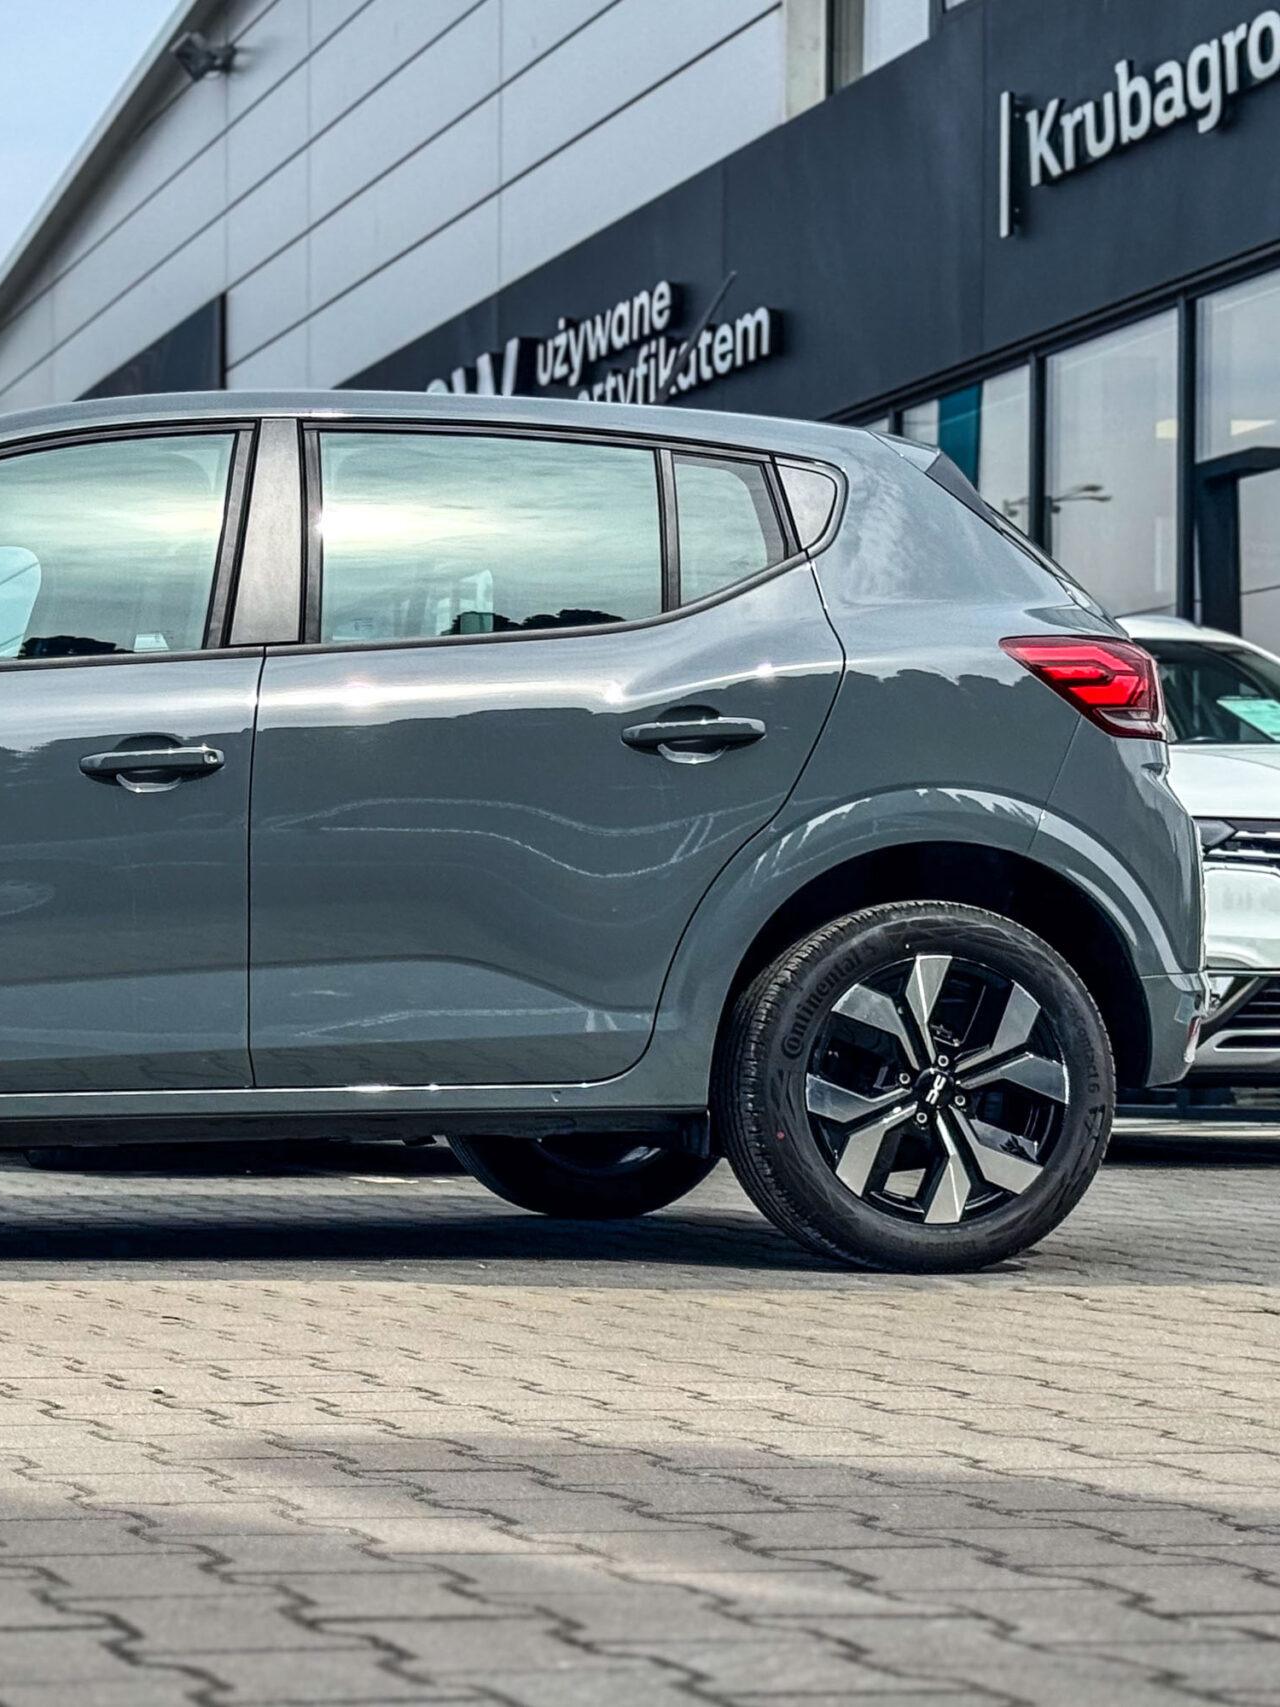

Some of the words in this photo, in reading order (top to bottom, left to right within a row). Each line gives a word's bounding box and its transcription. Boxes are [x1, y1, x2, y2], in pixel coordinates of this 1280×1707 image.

[1025, 9, 1280, 188] Krubagro
[536, 280, 670, 387] używane
[577, 306, 770, 403] rtyfikatem
[780, 948, 863, 1060] Continental
